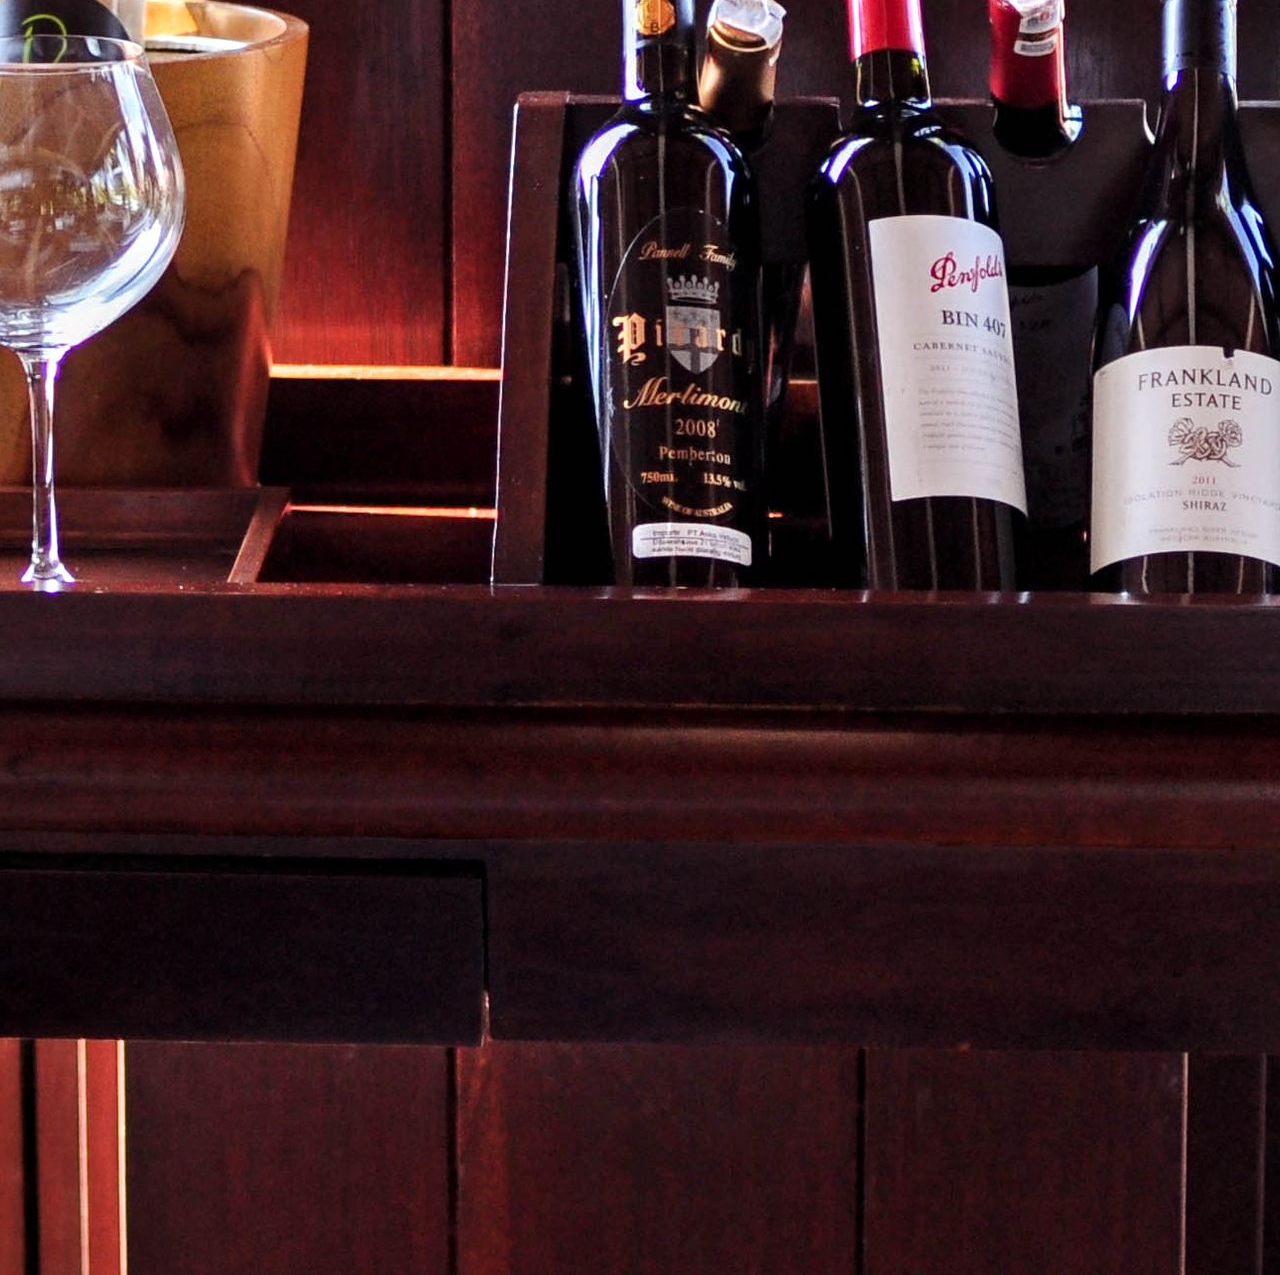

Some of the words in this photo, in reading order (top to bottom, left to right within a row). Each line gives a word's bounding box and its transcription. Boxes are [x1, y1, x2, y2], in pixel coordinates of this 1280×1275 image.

[699, 243, 737, 271] Family
[941, 309, 978, 327] BIN
[983, 317, 1006, 339] 407
[913, 343, 978, 352] CABERNET
[1138, 368, 1272, 395] FRANKLAND
[1171, 392, 1243, 411] ESTATE
[675, 418, 717, 439] 2008
[659, 446, 732, 466] Pemberton
[1192, 475, 1217, 485] 2011
[1182, 499, 1227, 512] SHIRAZ
